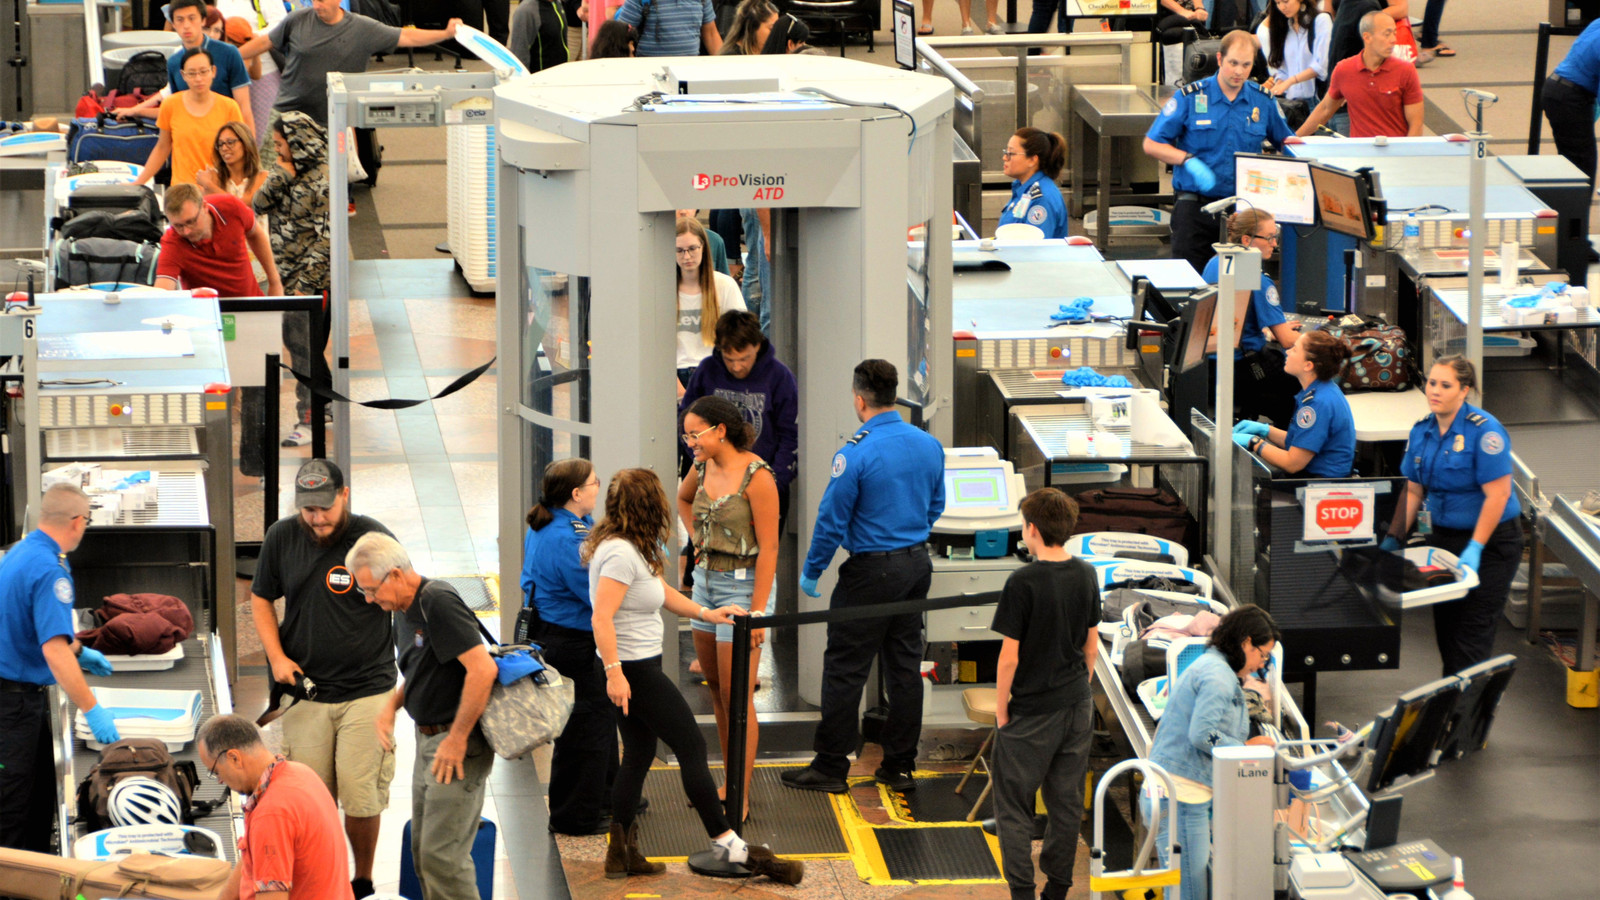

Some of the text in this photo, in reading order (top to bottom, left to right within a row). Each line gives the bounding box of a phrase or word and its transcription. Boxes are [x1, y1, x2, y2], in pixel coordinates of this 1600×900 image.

[1477, 141, 1485, 159] 8
[713, 173, 785, 187] ProVision
[753, 187, 785, 200] ATD
[1225, 255, 1233, 274] 7
[25, 319, 33, 338] 6
[1321, 507, 1359, 520] STOP
[329, 574, 350, 585] IES
[1237, 768, 1269, 778] iLane
